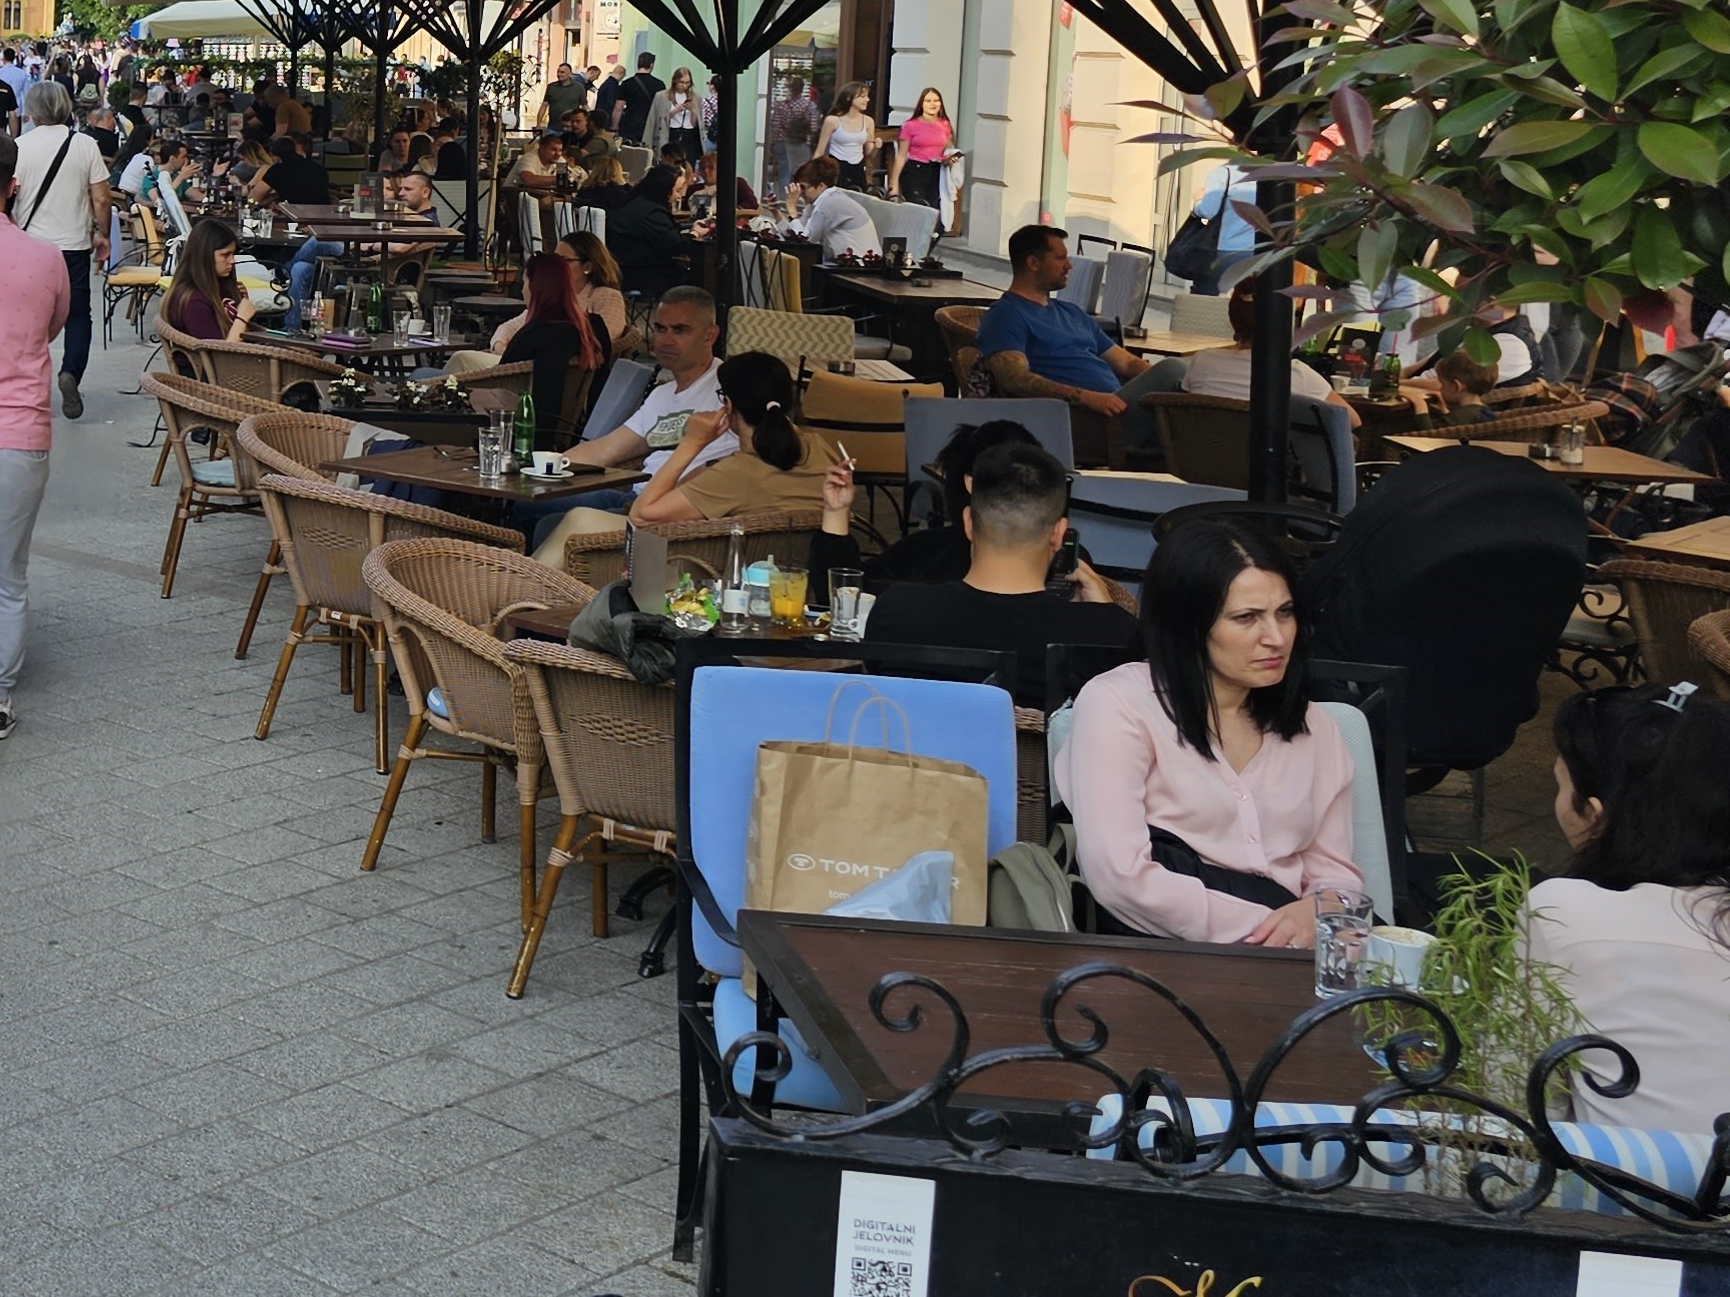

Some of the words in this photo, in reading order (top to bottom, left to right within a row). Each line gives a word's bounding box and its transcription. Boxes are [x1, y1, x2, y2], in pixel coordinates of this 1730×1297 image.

[819, 858, 869, 878] TOM
[853, 1218, 916, 1235] DIGITALNI
[852, 1230, 915, 1247] JELOVNIK
[854, 1244, 886, 1255] DIGITAL
[887, 1248, 912, 1257] MENU
